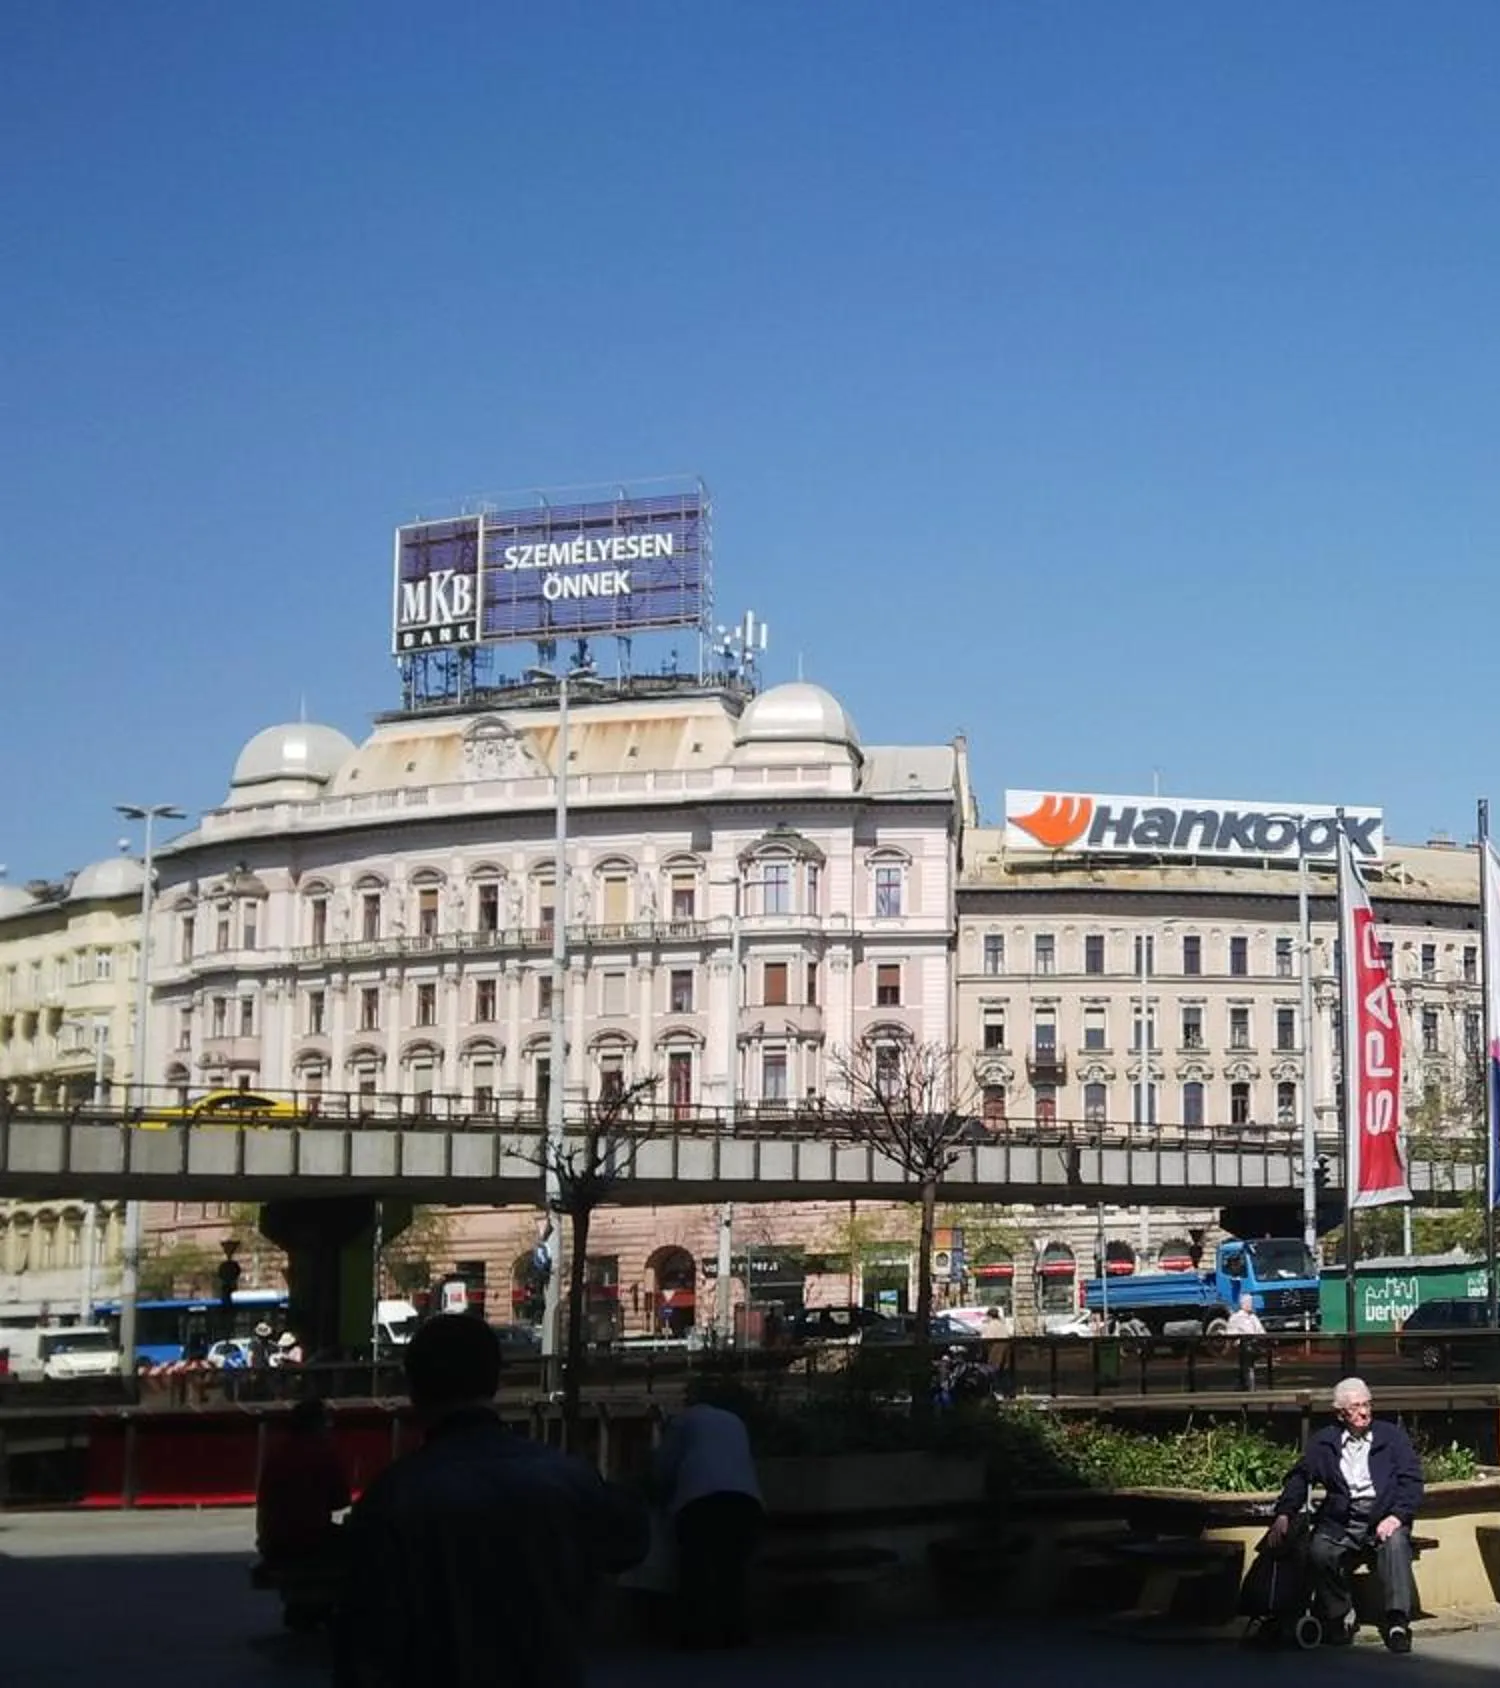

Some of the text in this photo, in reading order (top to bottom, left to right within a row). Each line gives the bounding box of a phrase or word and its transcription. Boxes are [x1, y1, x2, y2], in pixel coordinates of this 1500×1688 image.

[503, 532, 674, 571] SZEMÉLYESEN
[400, 568, 474, 625] MKB
[542, 569, 632, 601] ÖNNEK
[403, 625, 472, 648] BANK
